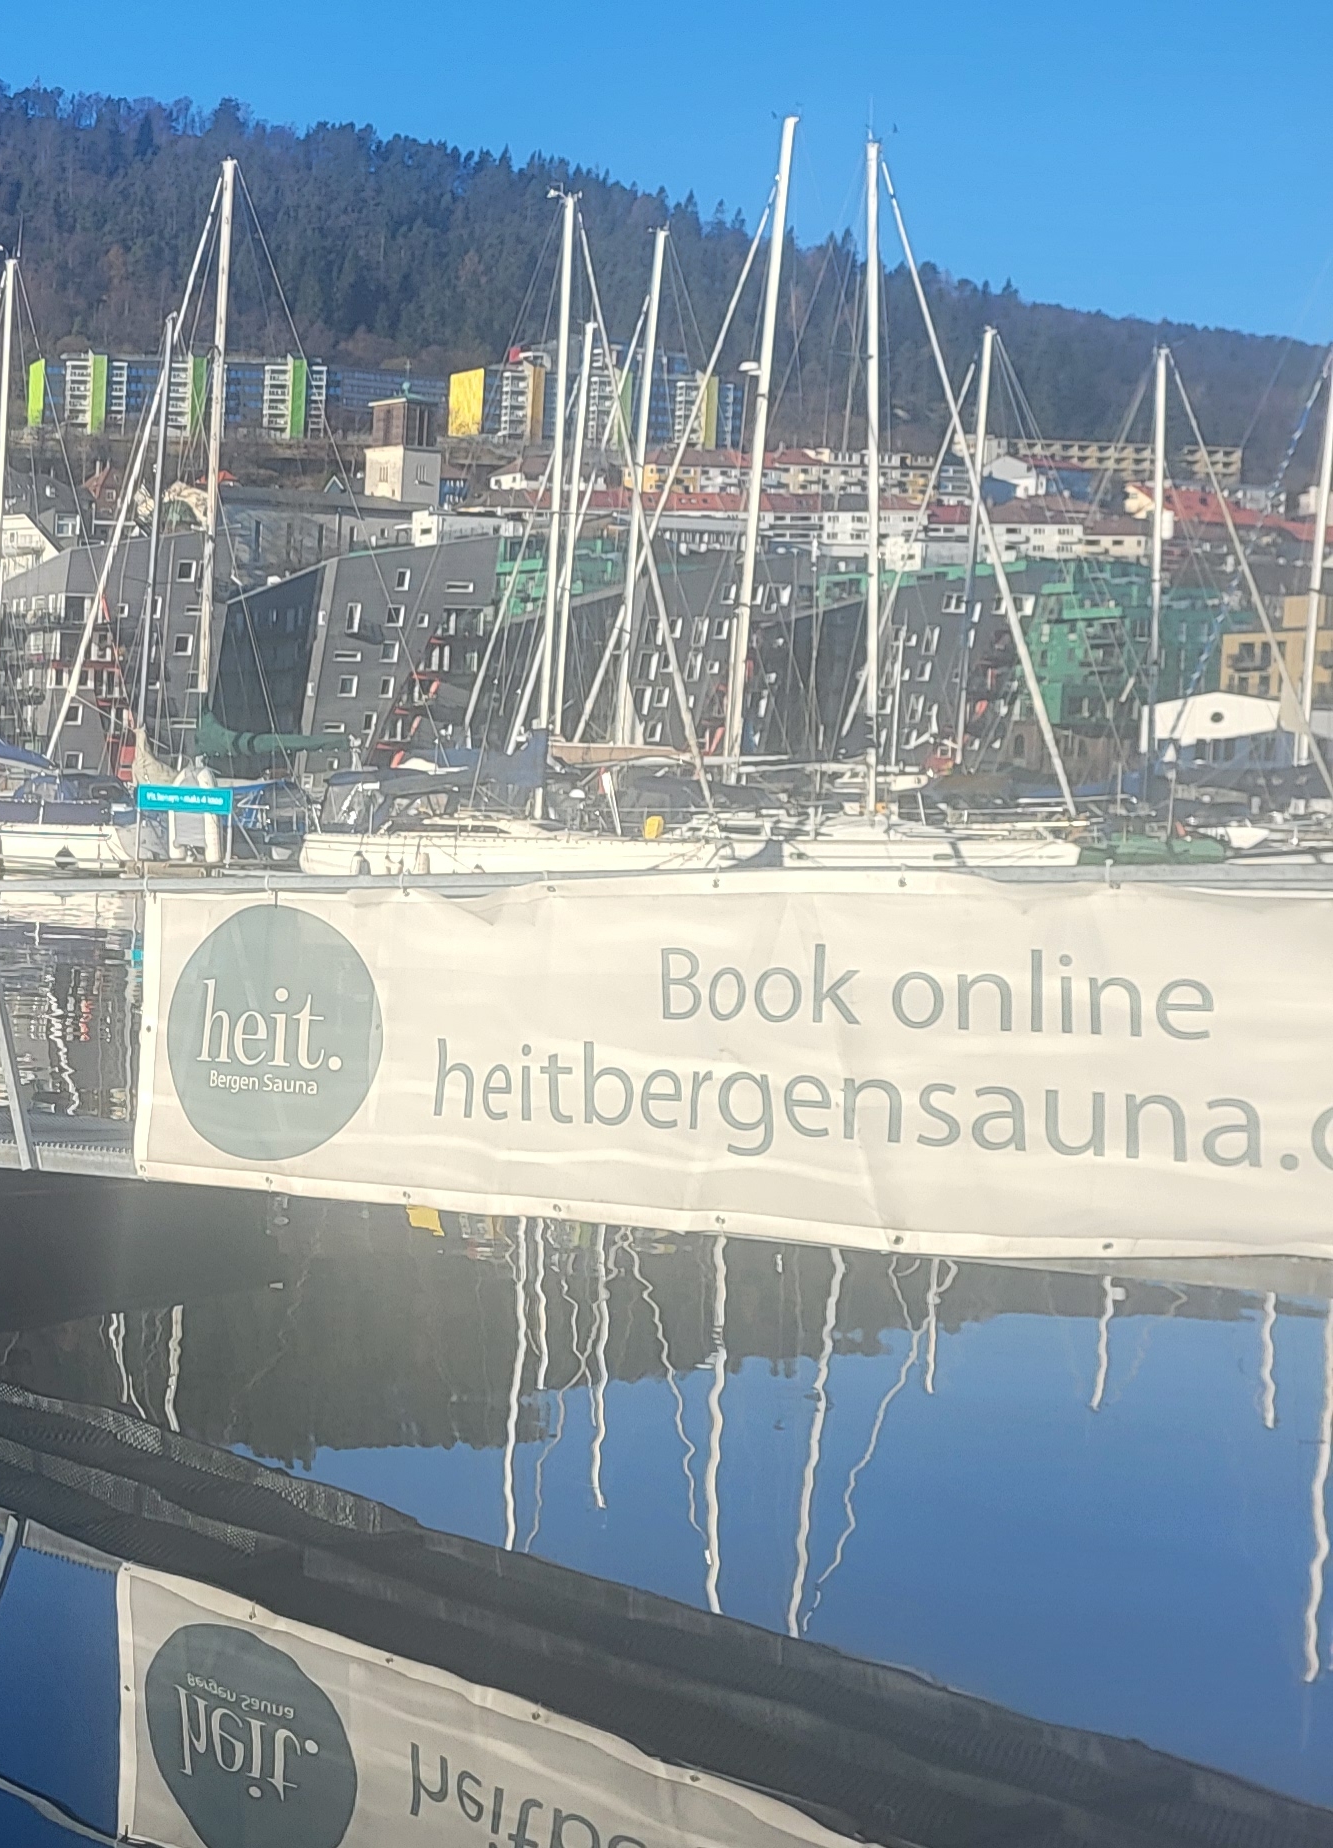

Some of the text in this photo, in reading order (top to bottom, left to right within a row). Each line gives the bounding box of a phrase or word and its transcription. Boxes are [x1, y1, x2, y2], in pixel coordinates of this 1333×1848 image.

[196, 978, 343, 1071] heit.
[661, 943, 1215, 1041] Book online
[209, 1069, 319, 1095] Bergen Sauna
